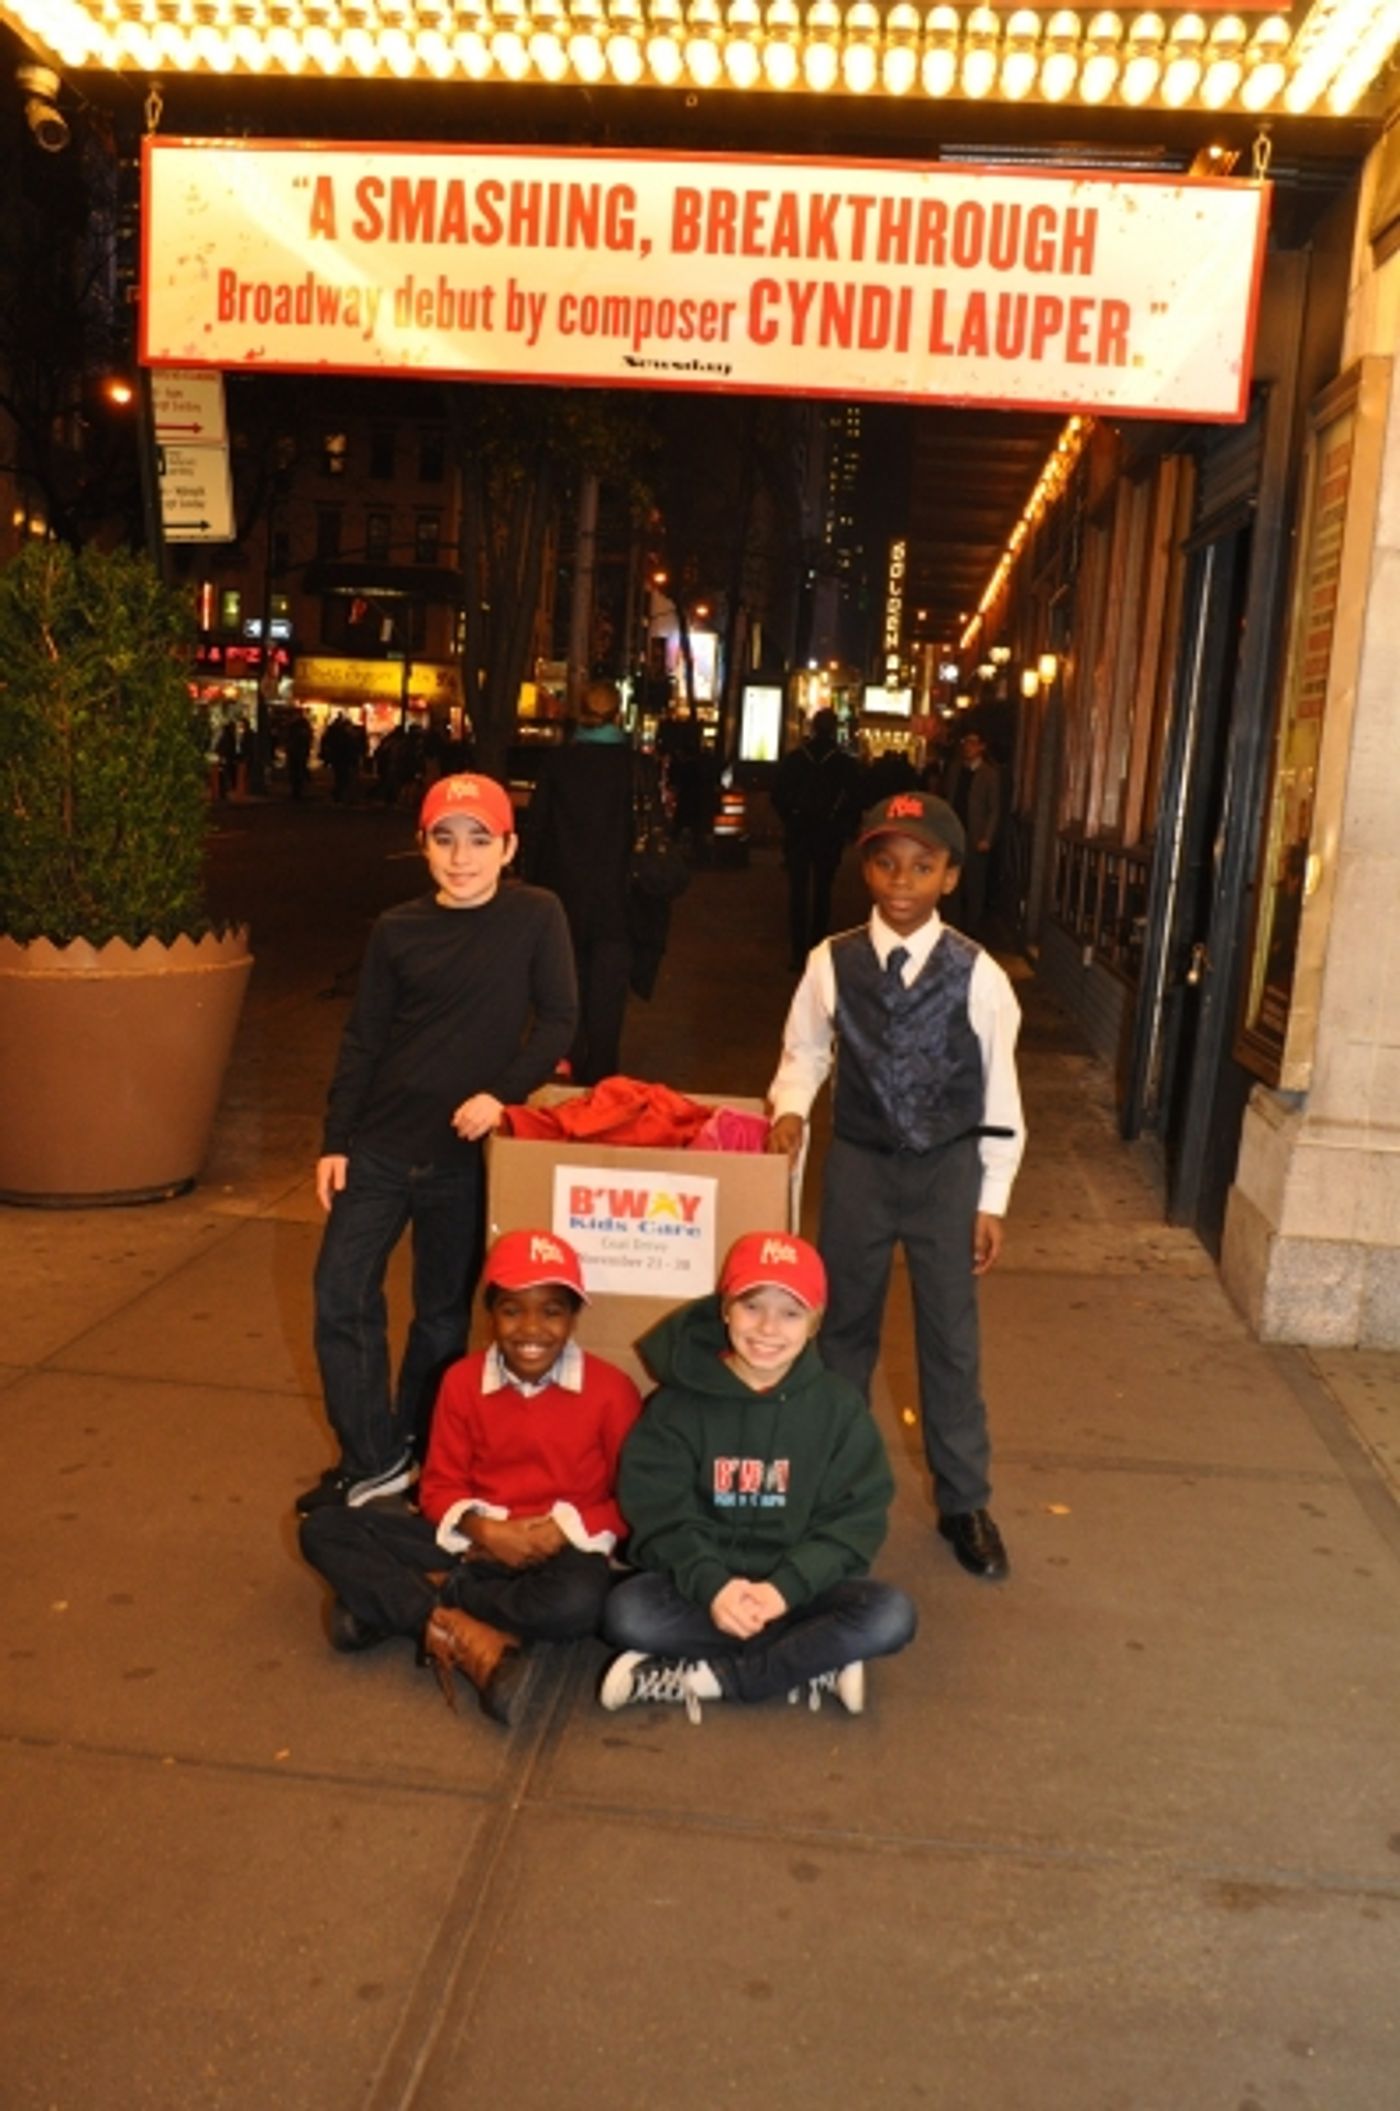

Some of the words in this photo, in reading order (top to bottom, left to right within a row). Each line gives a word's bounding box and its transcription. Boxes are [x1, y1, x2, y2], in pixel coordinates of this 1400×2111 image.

[352, 175, 654, 262] SMASHING,
[671, 187, 1099, 276] BREAKTHROUGH
[217, 267, 380, 341] Broadway
[393, 275, 496, 333] debut
[506, 278, 548, 346] by
[558, 289, 736, 351] composer
[747, 277, 914, 353] CYNDI
[570, 1186, 702, 1222] B'WAY
